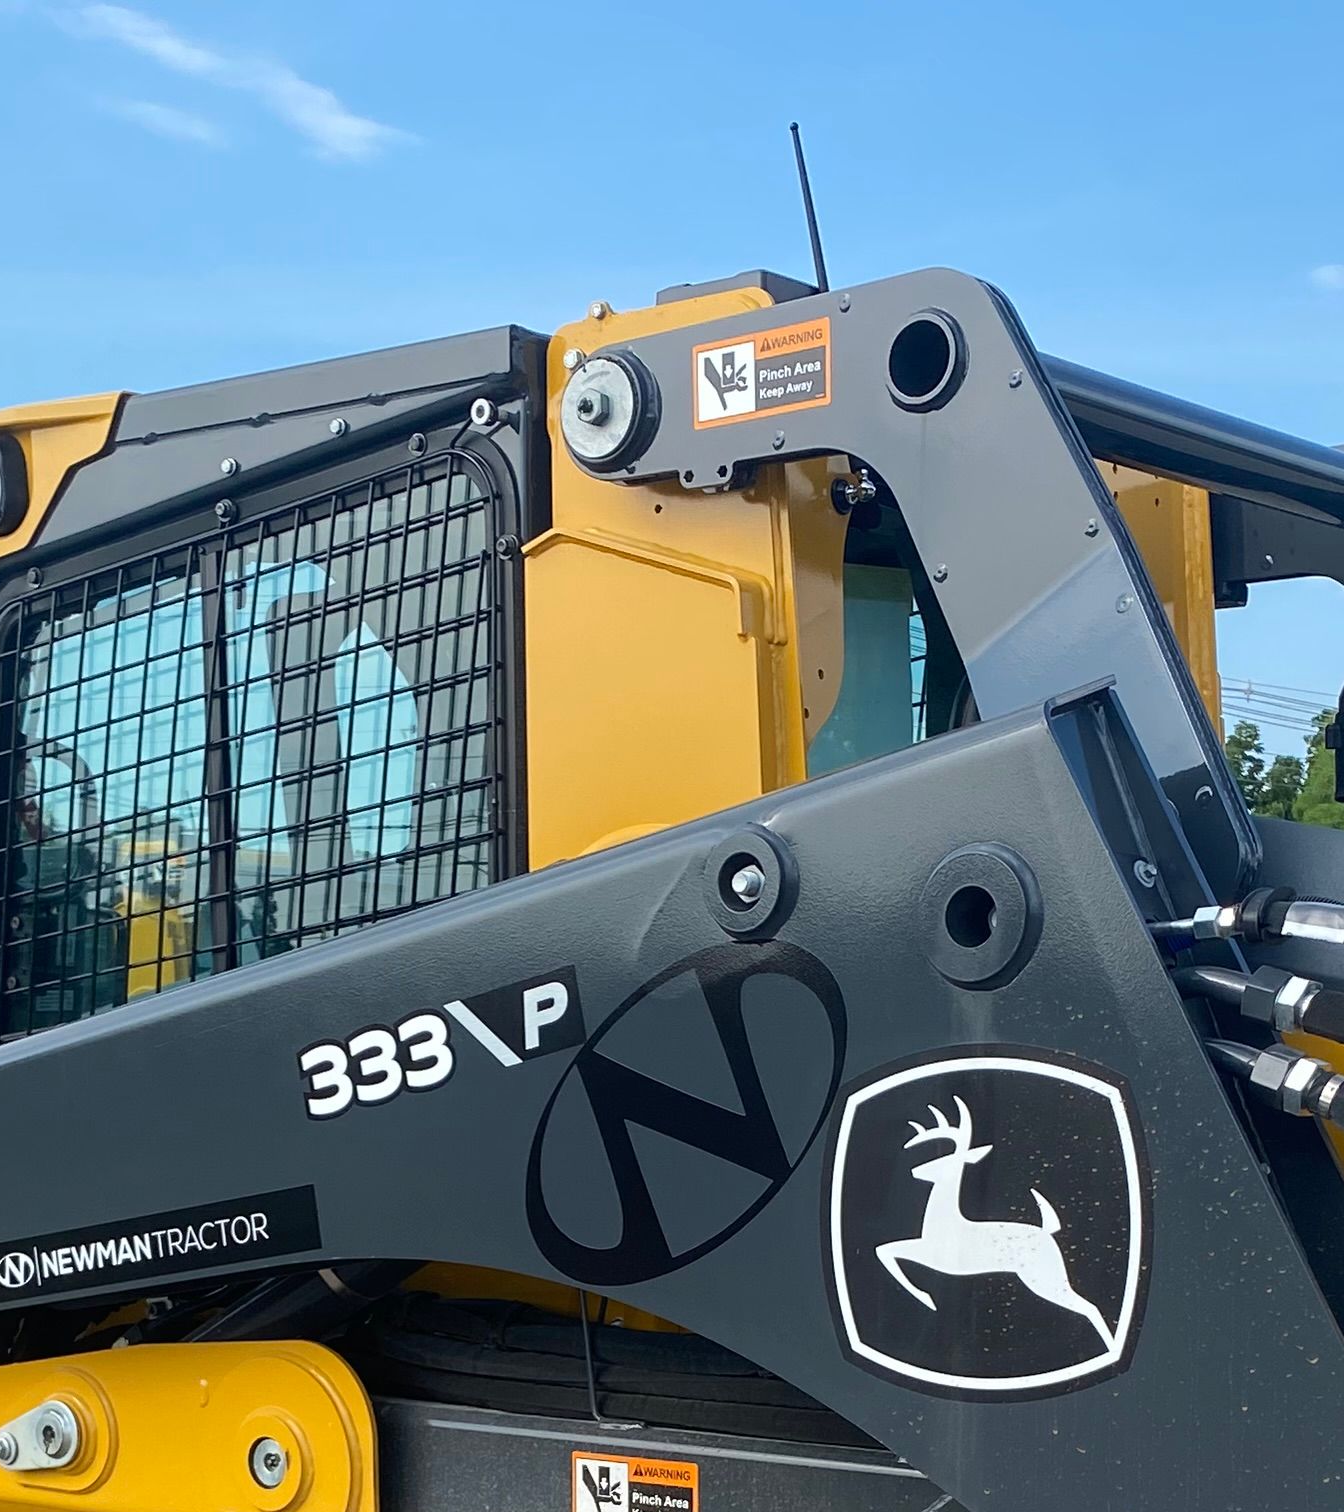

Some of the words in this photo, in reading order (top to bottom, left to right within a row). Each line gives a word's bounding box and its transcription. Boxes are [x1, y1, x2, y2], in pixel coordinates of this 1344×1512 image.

[771, 328, 823, 349] WARNING
[759, 365, 793, 383] Pinch
[794, 360, 822, 377] Area
[759, 385, 785, 400] Keep
[786, 380, 814, 396] Away
[41, 1212, 270, 1279] NEWMANTRACTOR
[642, 1465, 691, 1482] WARNING
[632, 1492, 662, 1508] Pinch
[664, 1494, 690, 1510] Area
